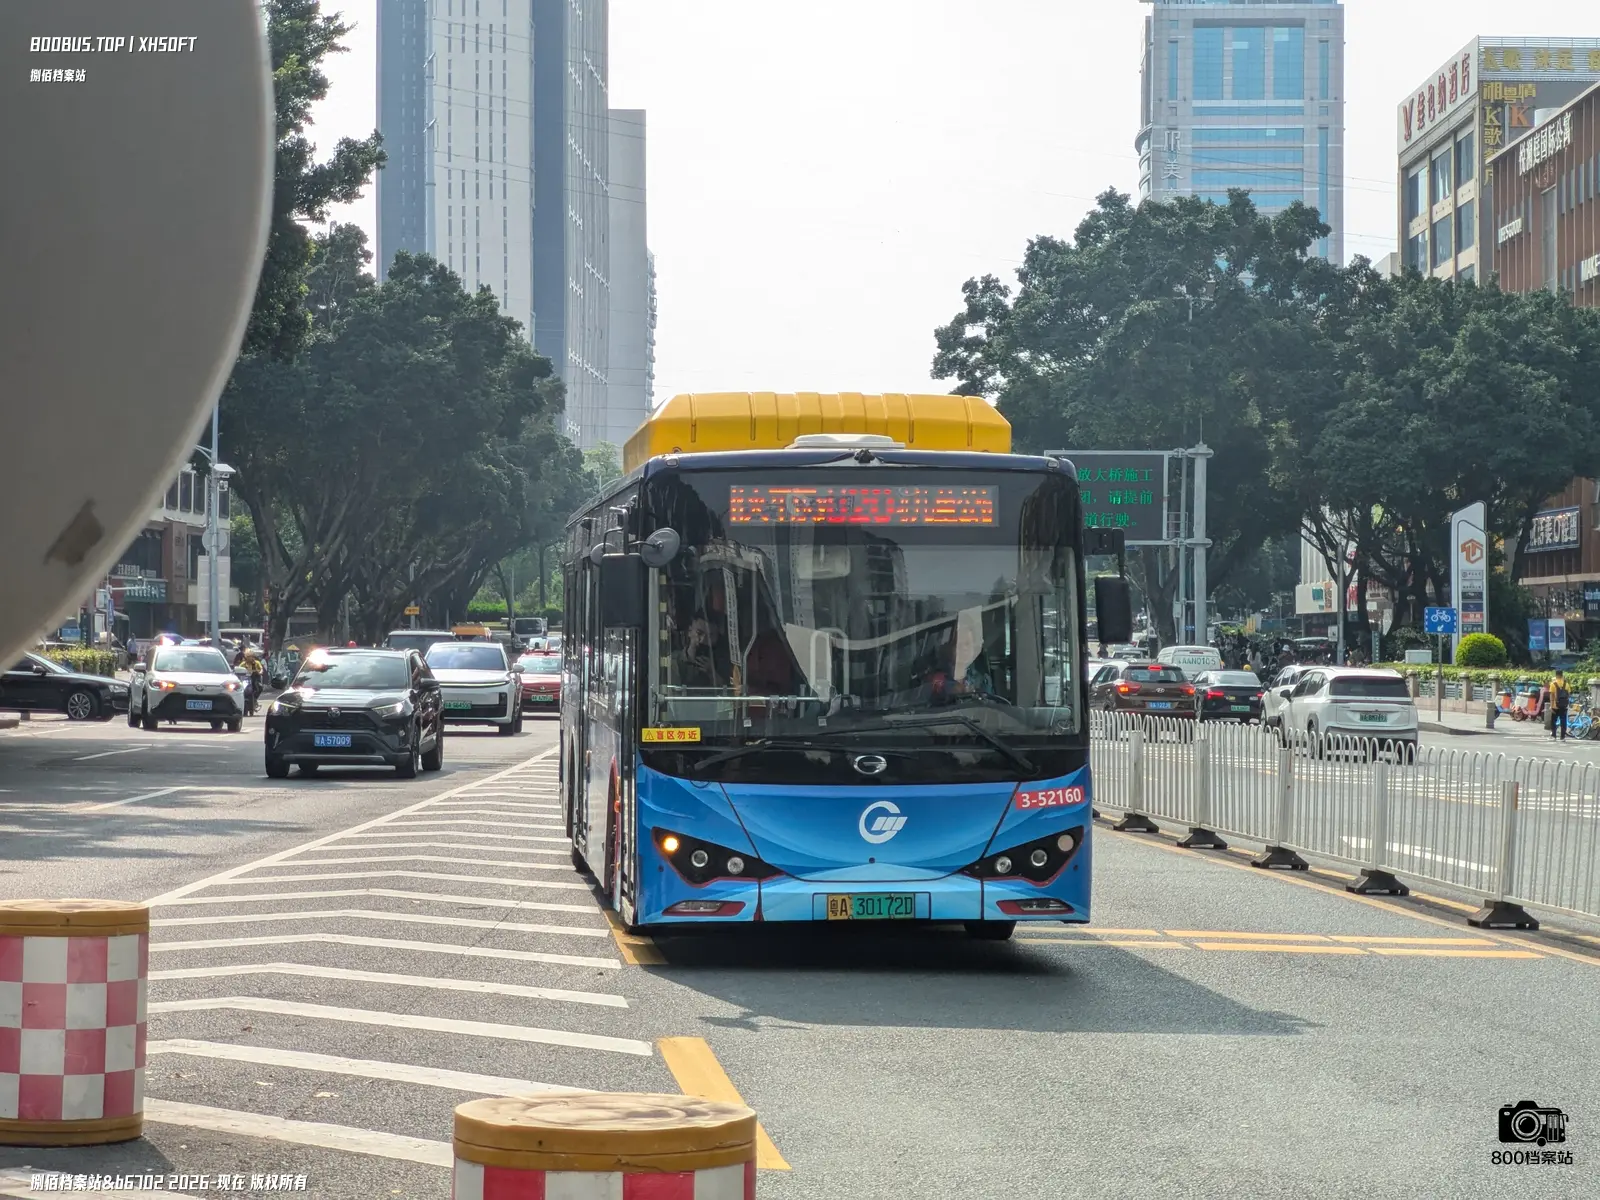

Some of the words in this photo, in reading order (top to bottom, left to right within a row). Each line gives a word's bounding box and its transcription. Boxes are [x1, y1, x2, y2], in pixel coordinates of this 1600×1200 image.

[656, 730, 697, 740] 盲区勿近
[1021, 788, 1081, 808] 3-52160
